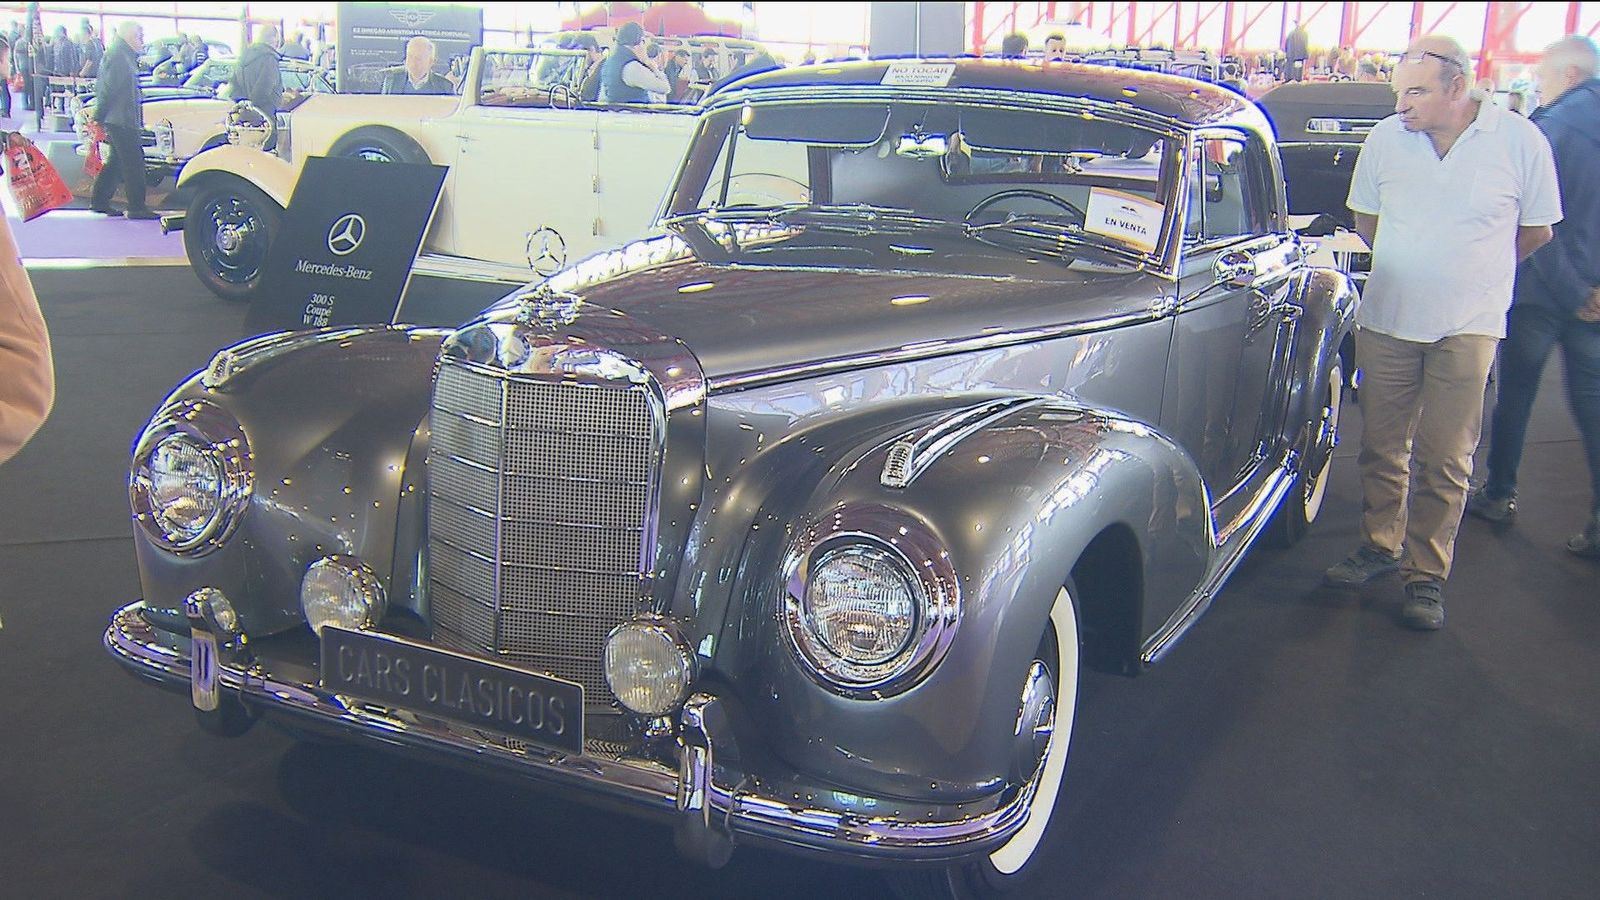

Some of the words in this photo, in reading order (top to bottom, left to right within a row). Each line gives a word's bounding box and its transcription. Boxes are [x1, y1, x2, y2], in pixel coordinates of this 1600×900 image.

[1105, 217, 1117, 226] EN
[1119, 220, 1147, 235] VENTA
[295, 260, 373, 280] Mercedes-Benz
[310, 293, 327, 304] 300
[327, 295, 335, 306] S
[306, 303, 332, 318] Coupé
[303, 314, 313, 324] W
[313, 316, 328, 327] 188
[339, 645, 411, 696] CARS
[423, 664, 566, 736] CLASICOS
